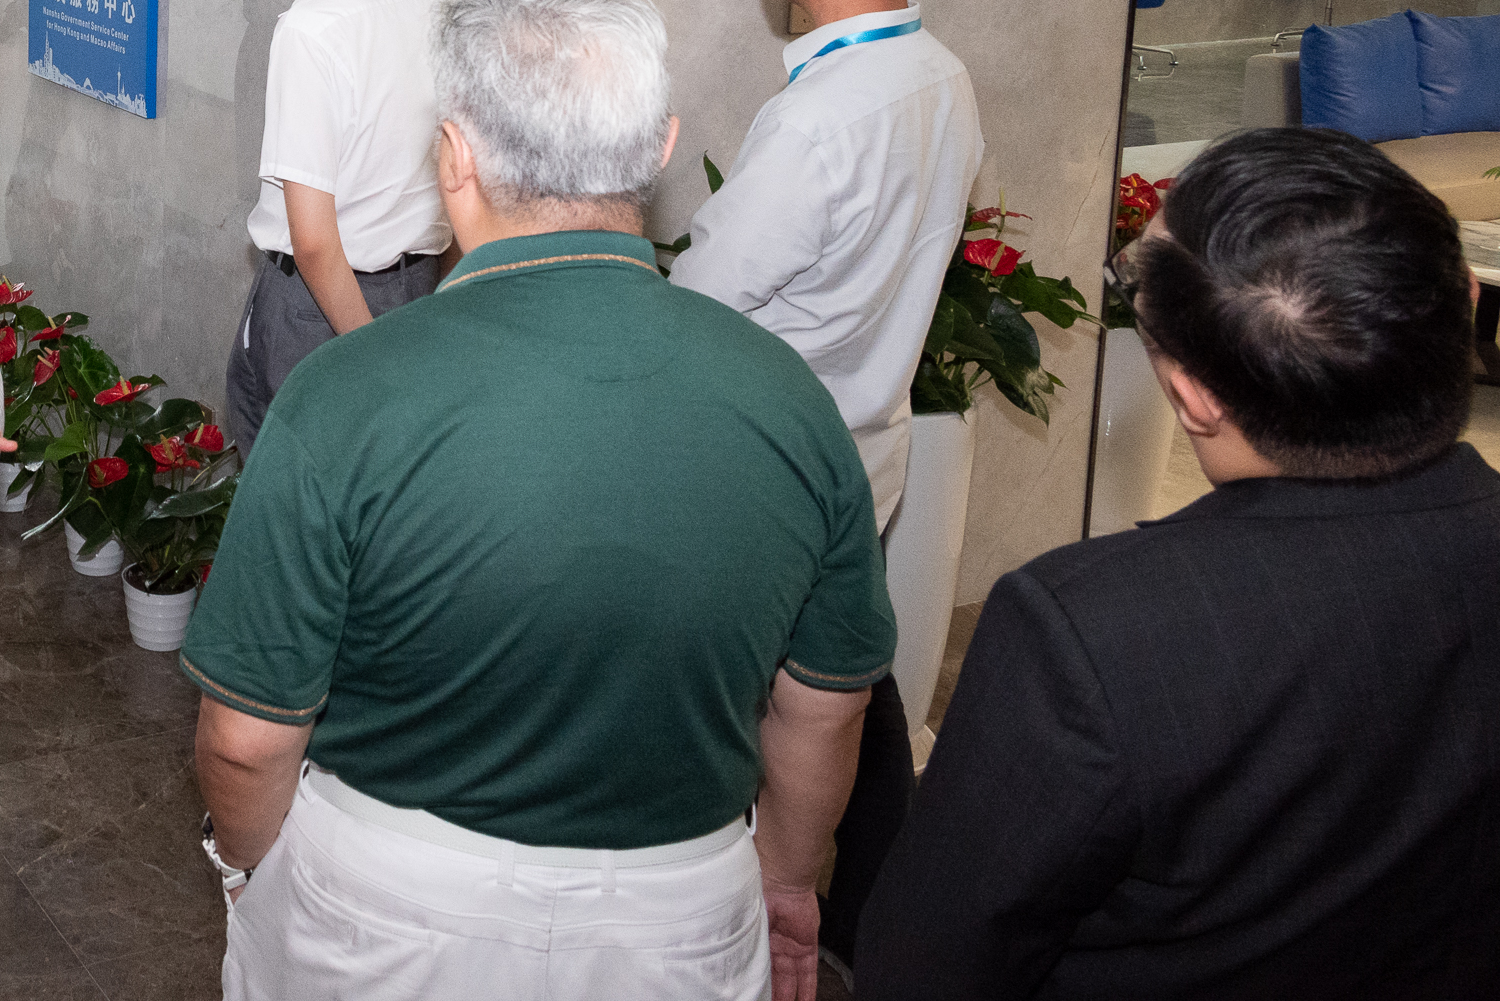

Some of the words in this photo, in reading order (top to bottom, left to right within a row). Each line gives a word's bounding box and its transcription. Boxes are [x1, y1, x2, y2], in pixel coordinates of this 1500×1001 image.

[43, 6, 60, 19] Nansha
[60, 11, 90, 29] Government
[91, 21, 110, 35] Service
[111, 28, 129, 41] Center
[54, 22, 66, 36] Hong
[67, 26, 79, 40] Kong
[80, 33, 89, 42] and
